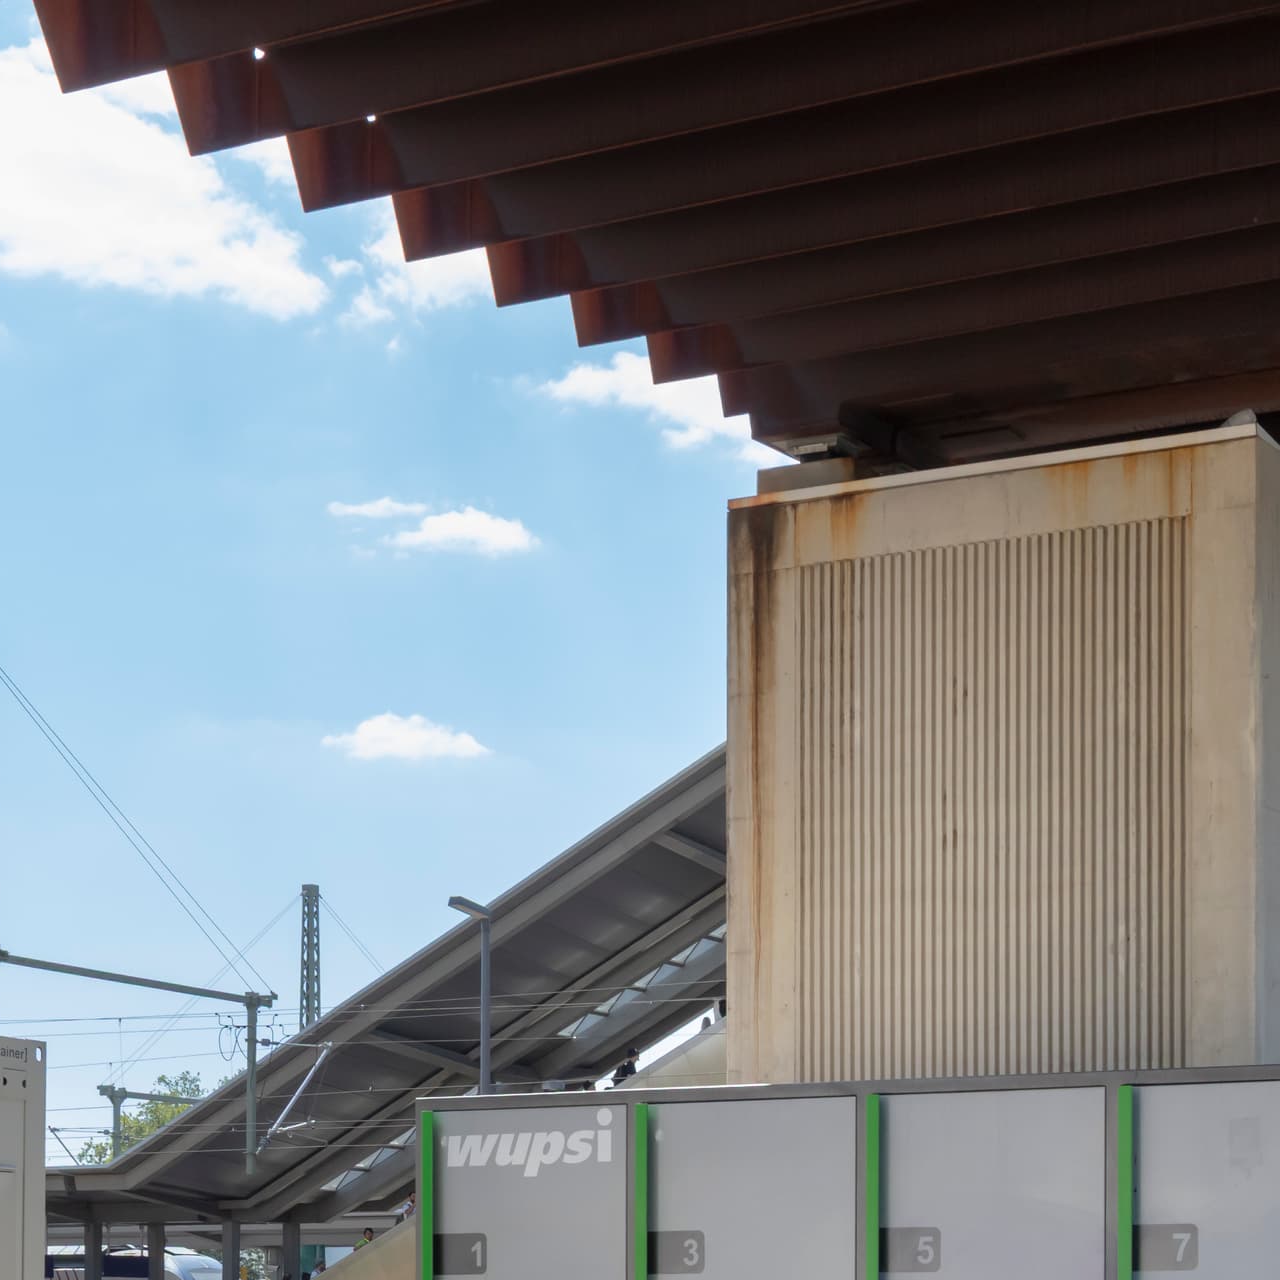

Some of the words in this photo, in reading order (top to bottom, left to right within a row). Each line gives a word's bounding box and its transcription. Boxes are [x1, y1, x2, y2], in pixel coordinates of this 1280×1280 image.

[447, 1108, 613, 1177] wupsi
[471, 1241, 482, 1267] 1
[683, 1238, 699, 1266] 3
[917, 1236, 934, 1264] 5
[1172, 1233, 1191, 1262] 7
